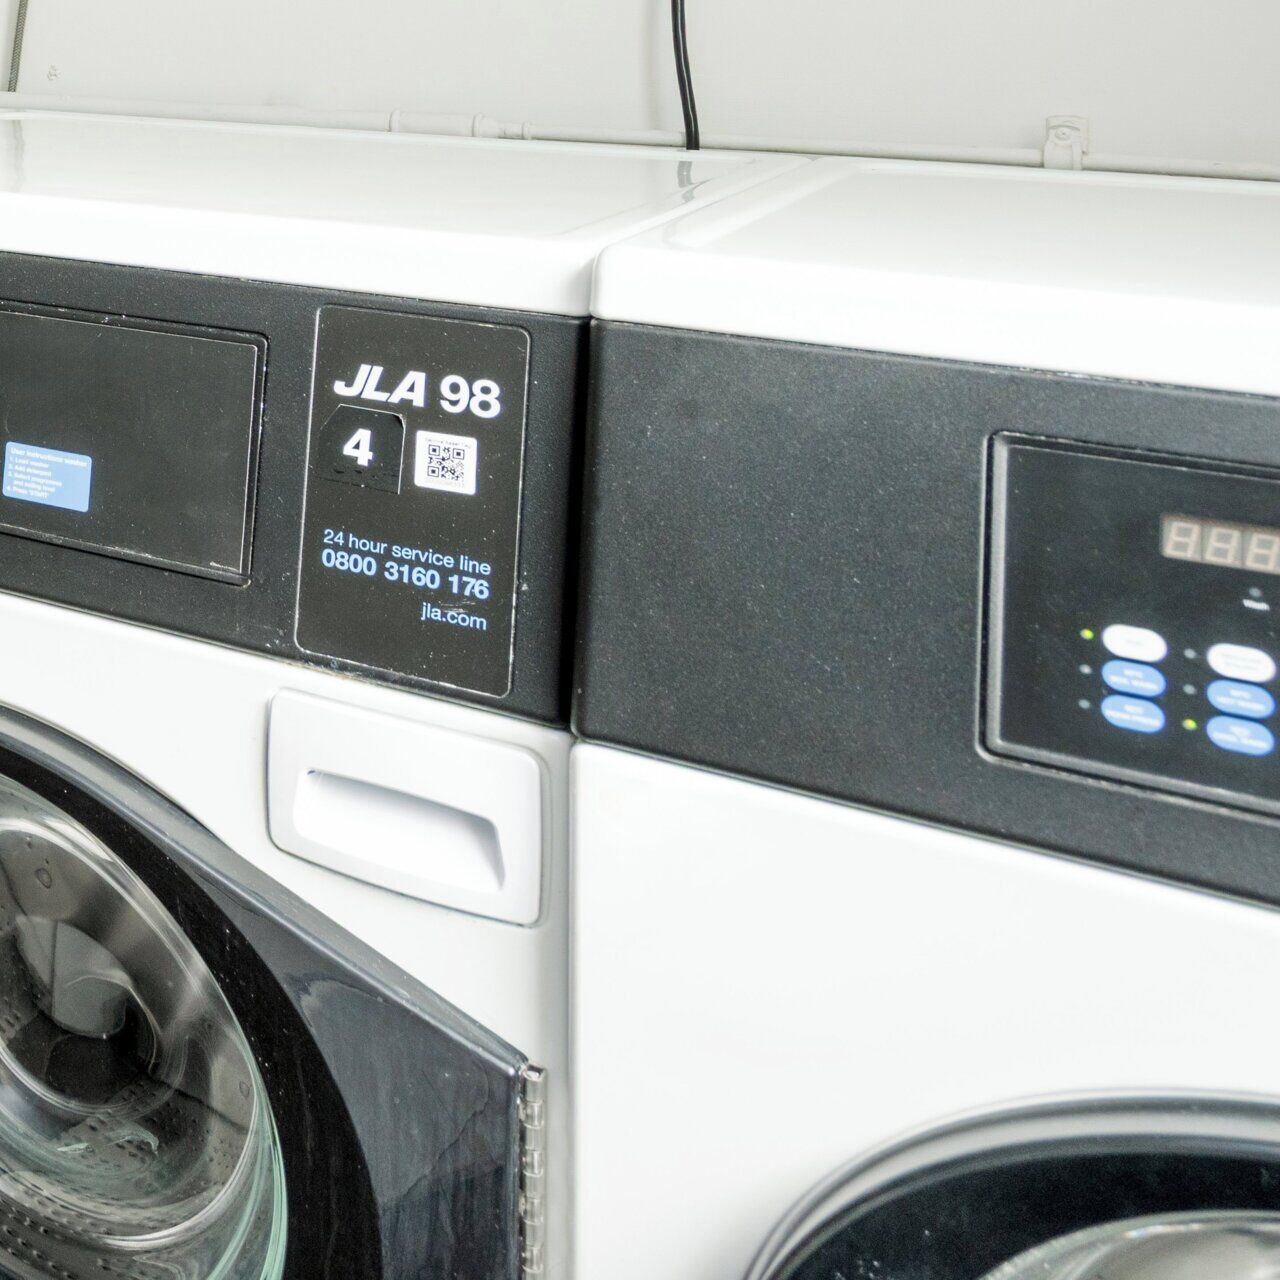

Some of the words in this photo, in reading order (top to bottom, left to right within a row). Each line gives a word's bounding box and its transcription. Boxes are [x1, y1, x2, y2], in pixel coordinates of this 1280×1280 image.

[333, 364, 427, 408] JLA
[440, 374, 502, 418] 98
[342, 428, 374, 466] 4
[322, 548, 376, 576] 0800
[384, 561, 440, 589] 3160
[448, 574, 490, 600] 176
[324, 528, 344, 546] 24
[348, 534, 388, 554] hour
[392, 545, 454, 568] service
[460, 554, 491, 576] line
[421, 602, 487, 630] jla.com
